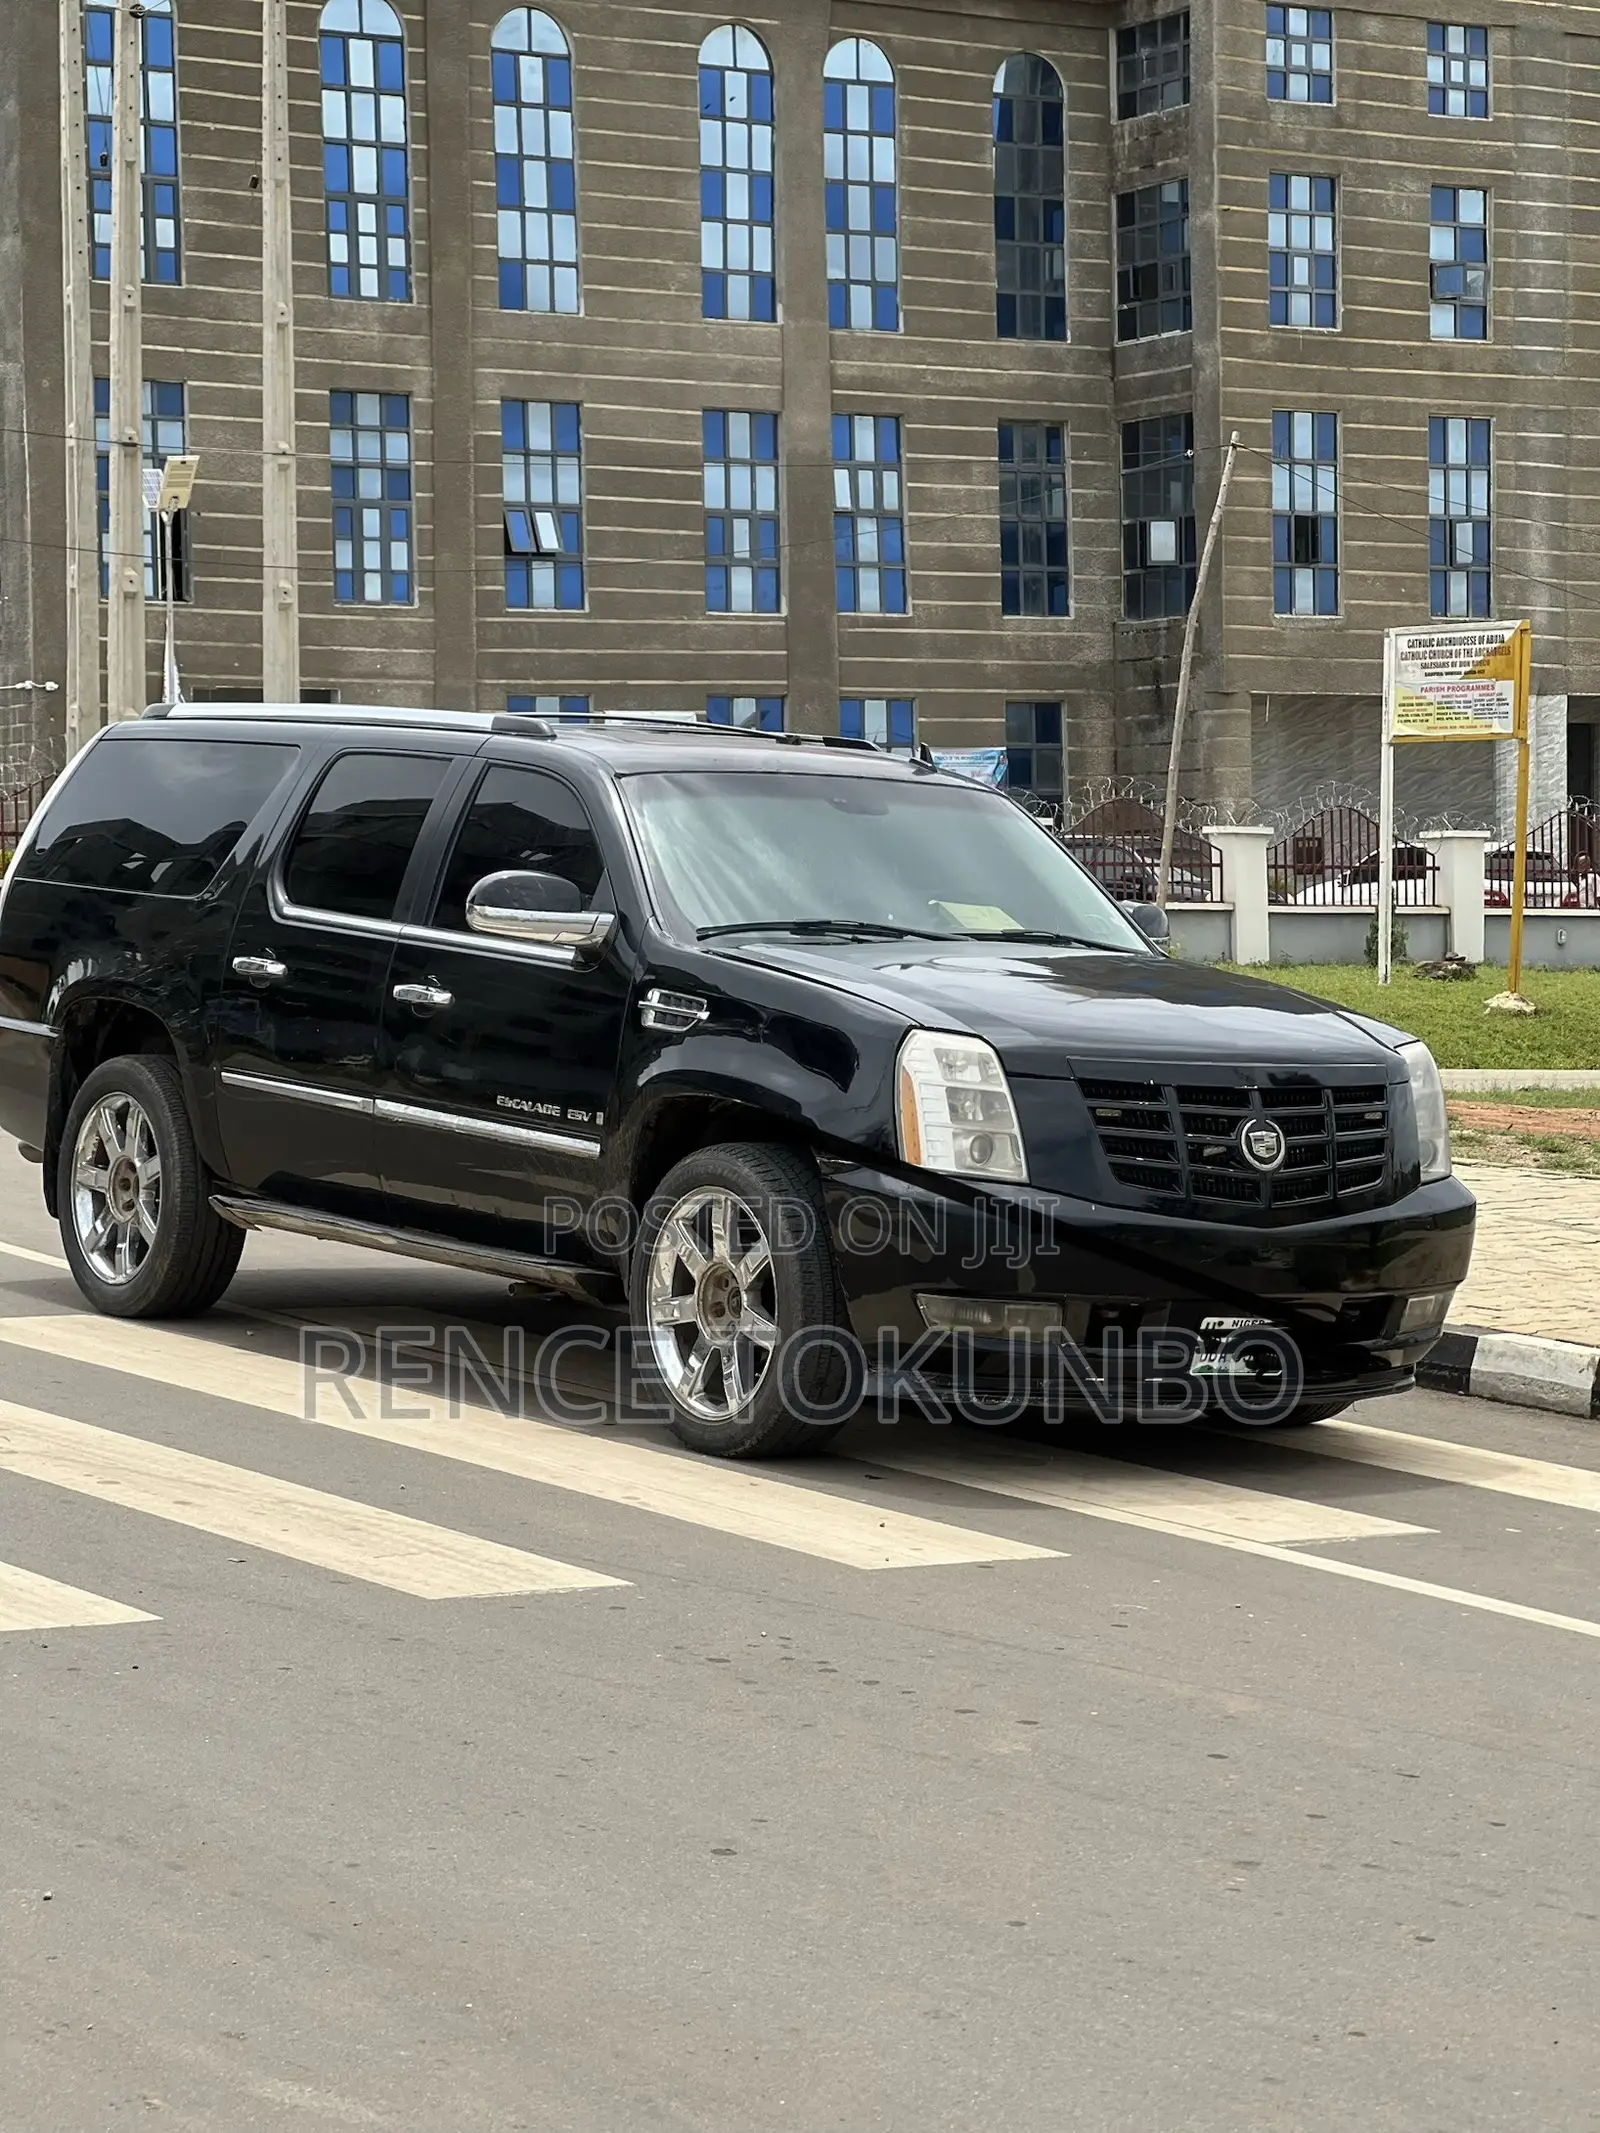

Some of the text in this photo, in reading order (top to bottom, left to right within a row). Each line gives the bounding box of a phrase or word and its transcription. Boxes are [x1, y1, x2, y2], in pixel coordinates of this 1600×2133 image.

[1407, 634, 1505, 649] CATHOLIC ARCHDIOCESE OF ABUJA
[1400, 650, 1428, 661] CATHOLIC
[1429, 649, 1453, 660] CHURCH
[1454, 648, 1462, 659] OF
[1463, 647, 1473, 658] THE
[1420, 661, 1450, 670] SALESIANS
[1451, 660, 1458, 668] OF
[1459, 660, 1471, 668] DON
[1420, 684, 1496, 694] PARISH PROGRAMMES
[496, 1094, 592, 1122] ESCALADE ESV
